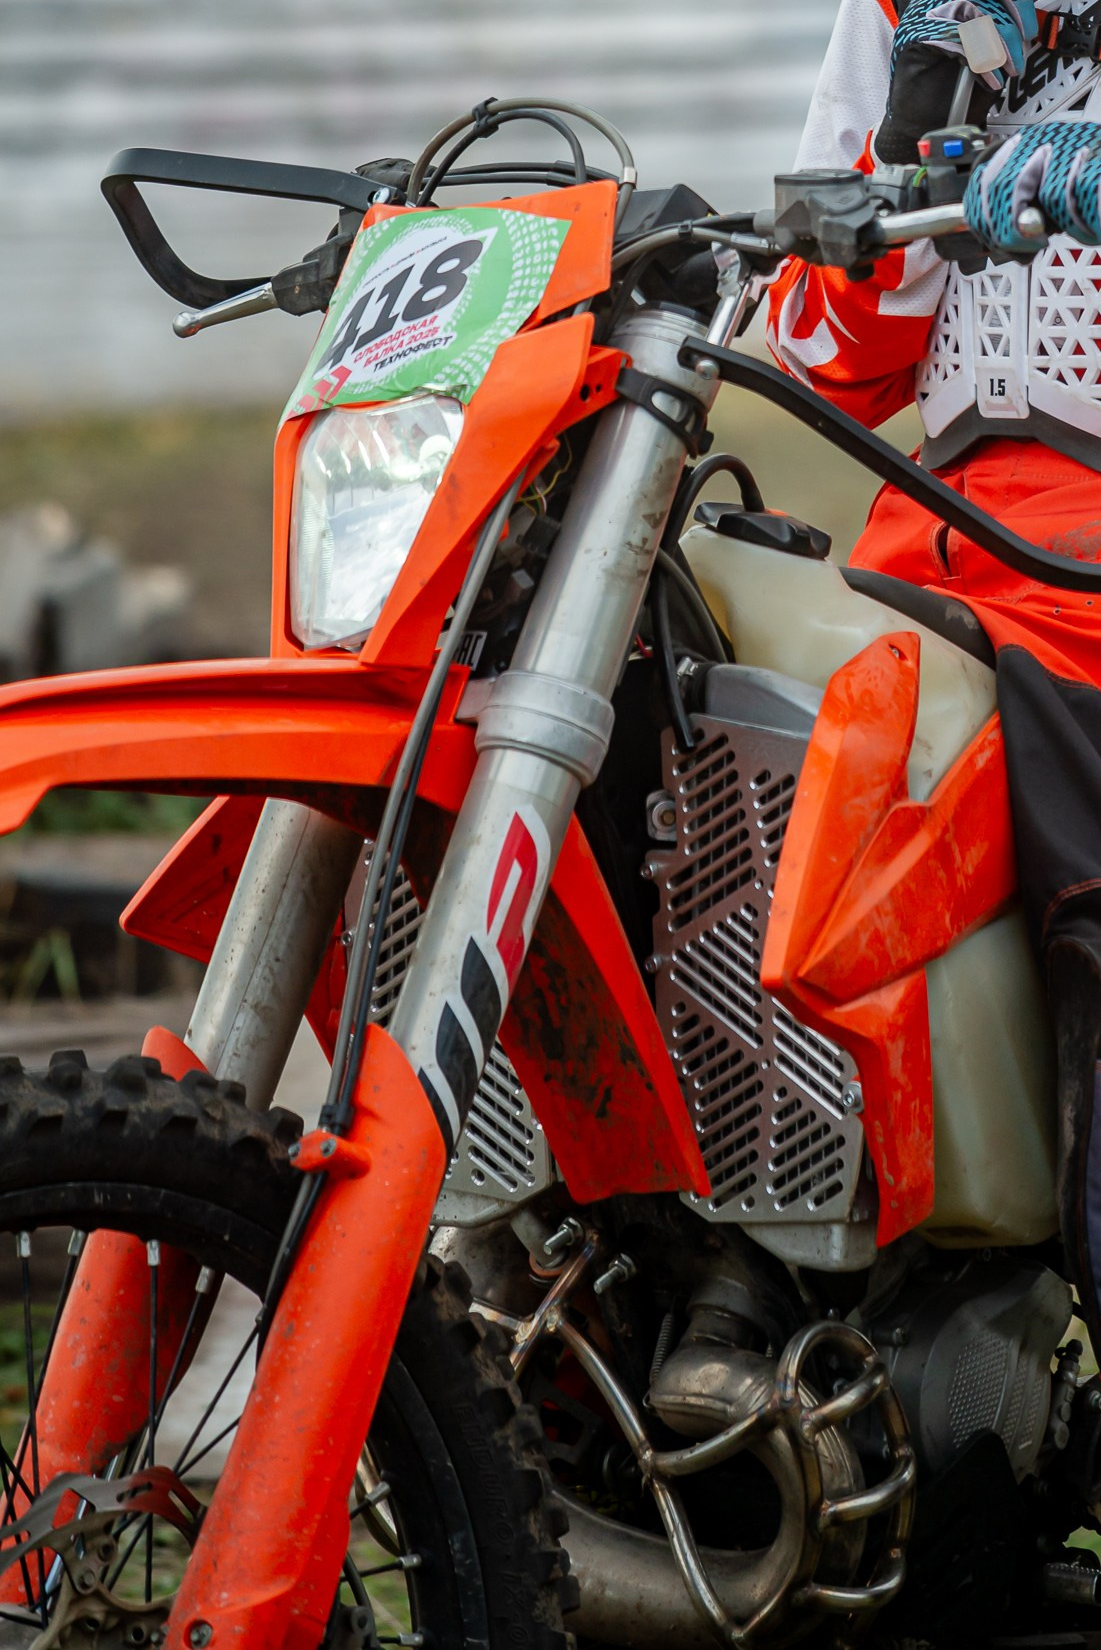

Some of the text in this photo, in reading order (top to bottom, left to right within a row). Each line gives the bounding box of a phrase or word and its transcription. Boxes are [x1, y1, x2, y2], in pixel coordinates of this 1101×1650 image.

[315, 239, 483, 373] 418
[354, 315, 439, 363] СЛОБОДСКАЯ
[363, 327, 440, 368] БАЛКА 2025
[373, 335, 453, 373] ТЕХНОФЕСТ
[990, 378, 1006, 396] 1.5
